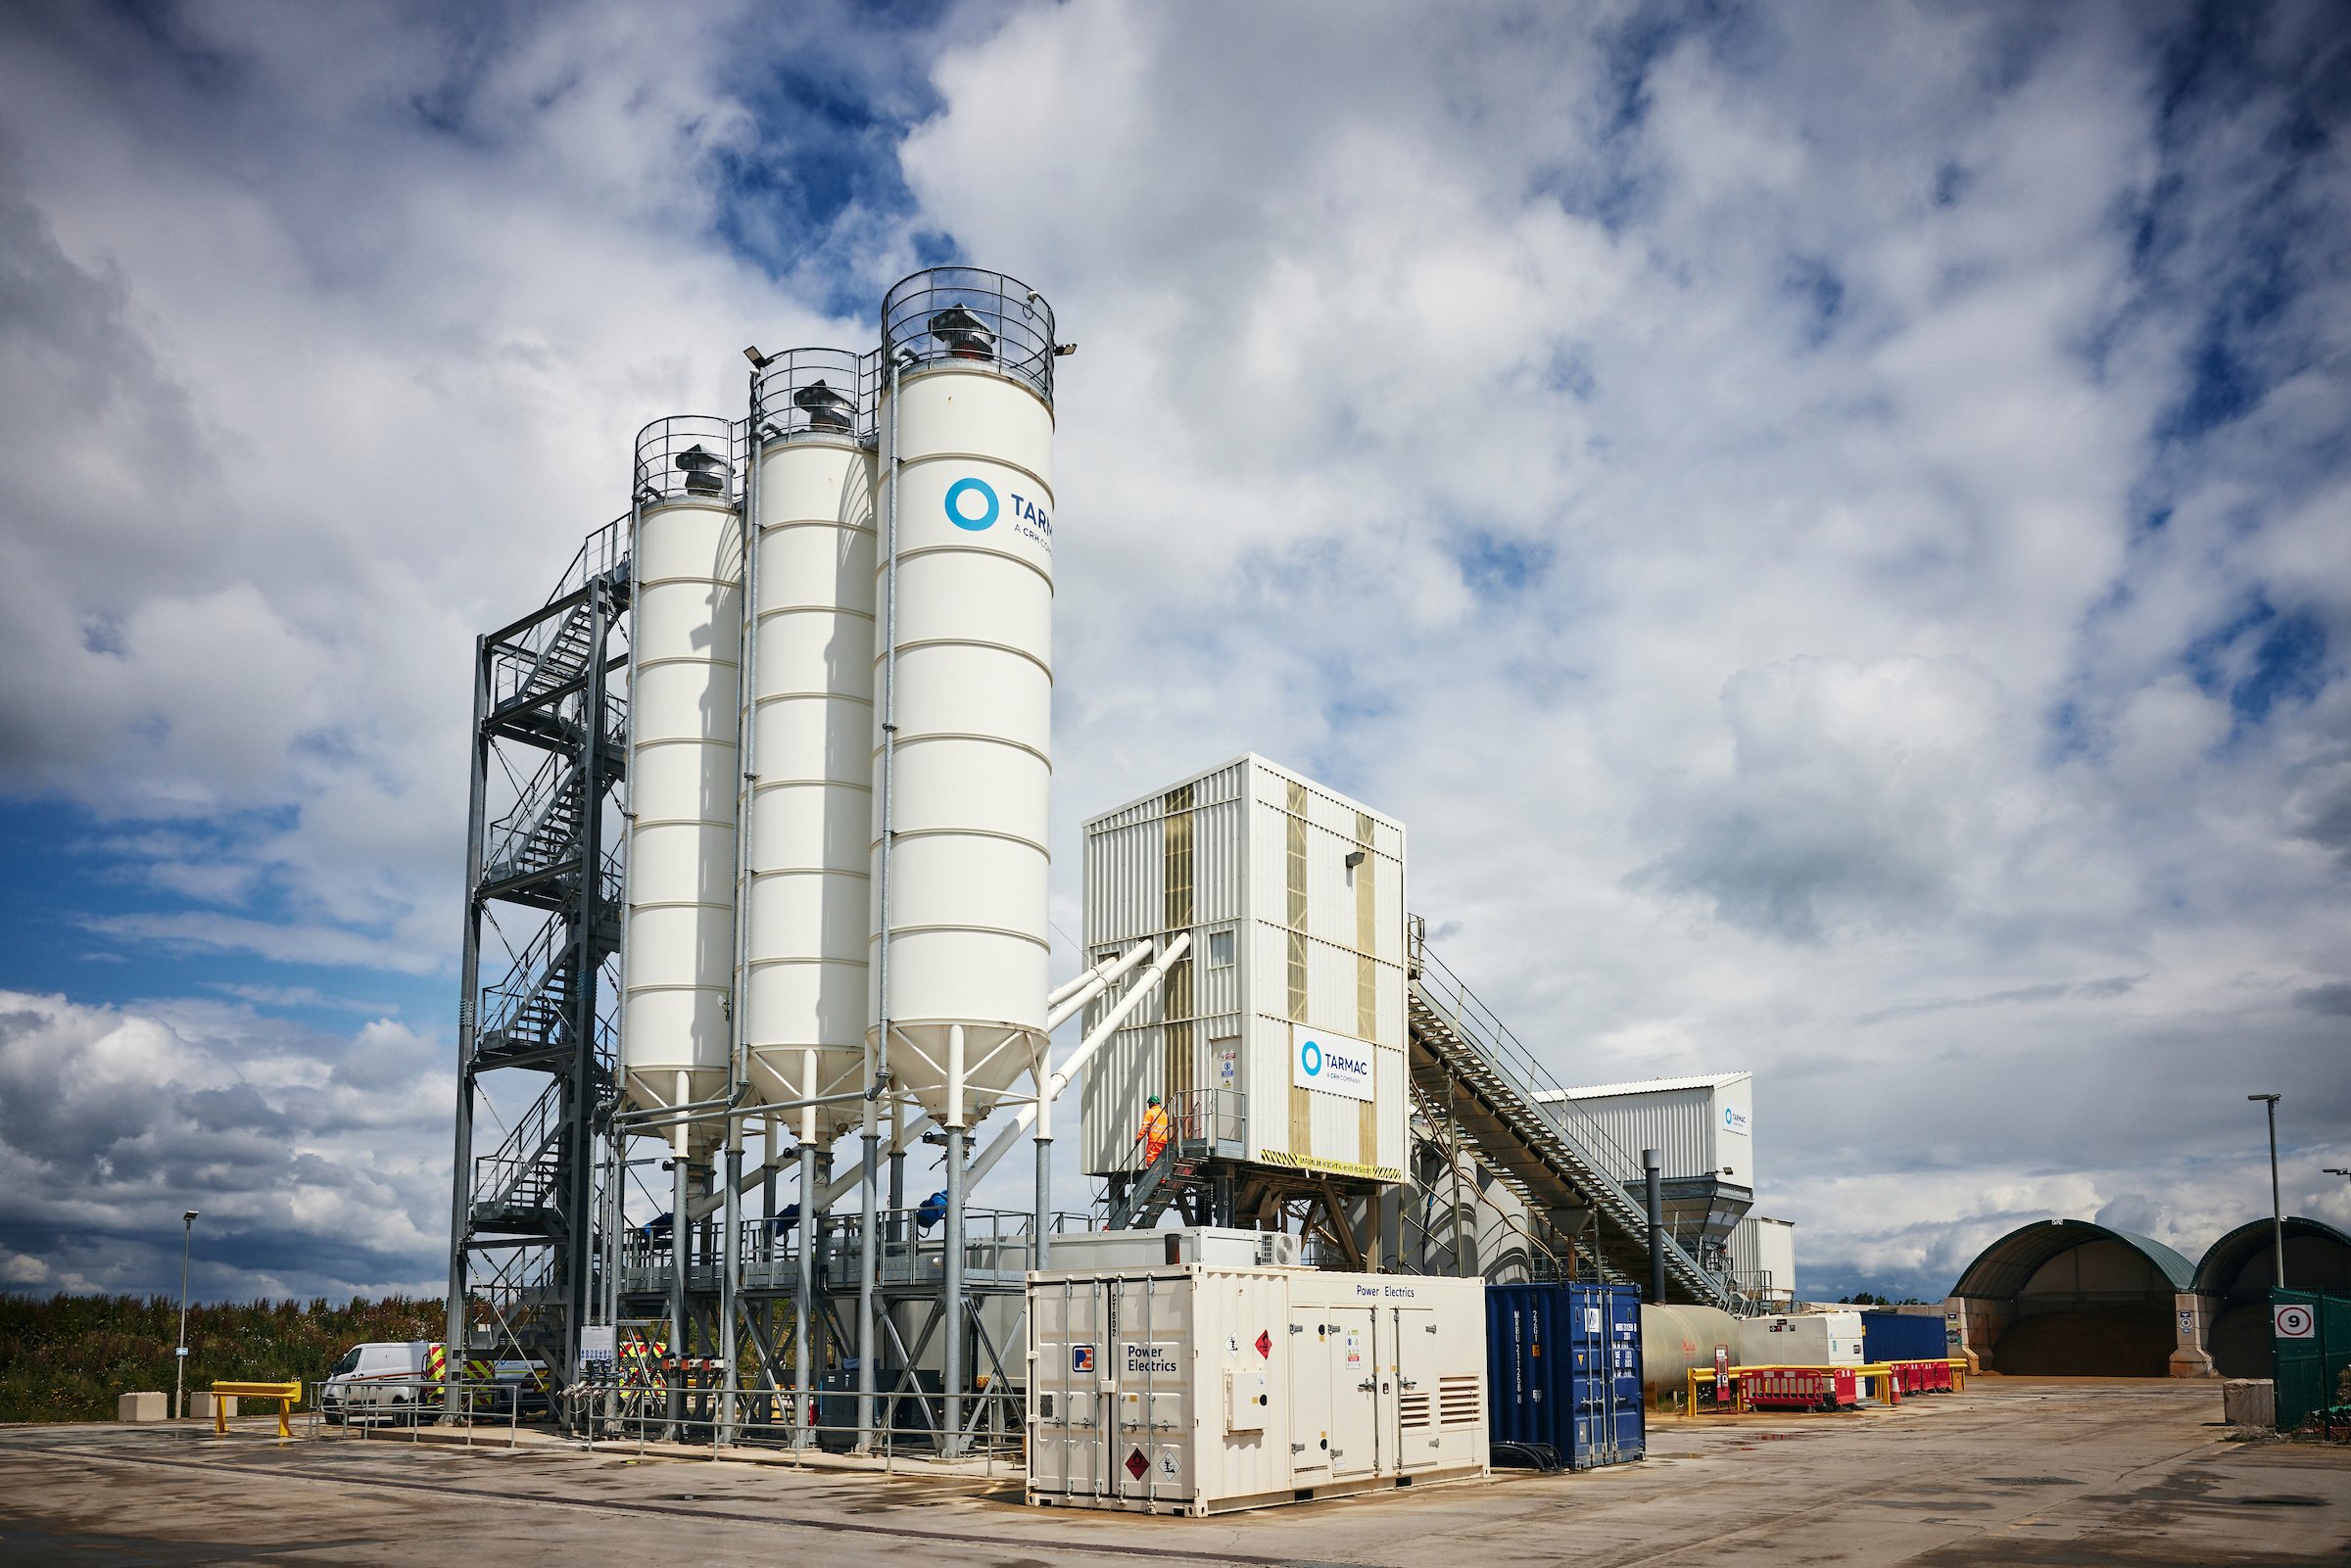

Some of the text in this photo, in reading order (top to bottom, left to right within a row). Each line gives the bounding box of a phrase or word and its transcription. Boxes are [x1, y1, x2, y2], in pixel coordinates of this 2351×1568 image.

[1011, 494, 1052, 537] TARM
[1014, 524, 1039, 544] A CRH
[1325, 1053, 1367, 1075] TARMAC
[1357, 1284, 1415, 1298] Power Electrics
[2287, 1314, 2300, 1328] 9
[1128, 1345, 1163, 1357] Power
[1075, 1349, 1093, 1369] PE
[1128, 1358, 1176, 1372] Electrics
[1517, 1395, 1522, 1404] 8
